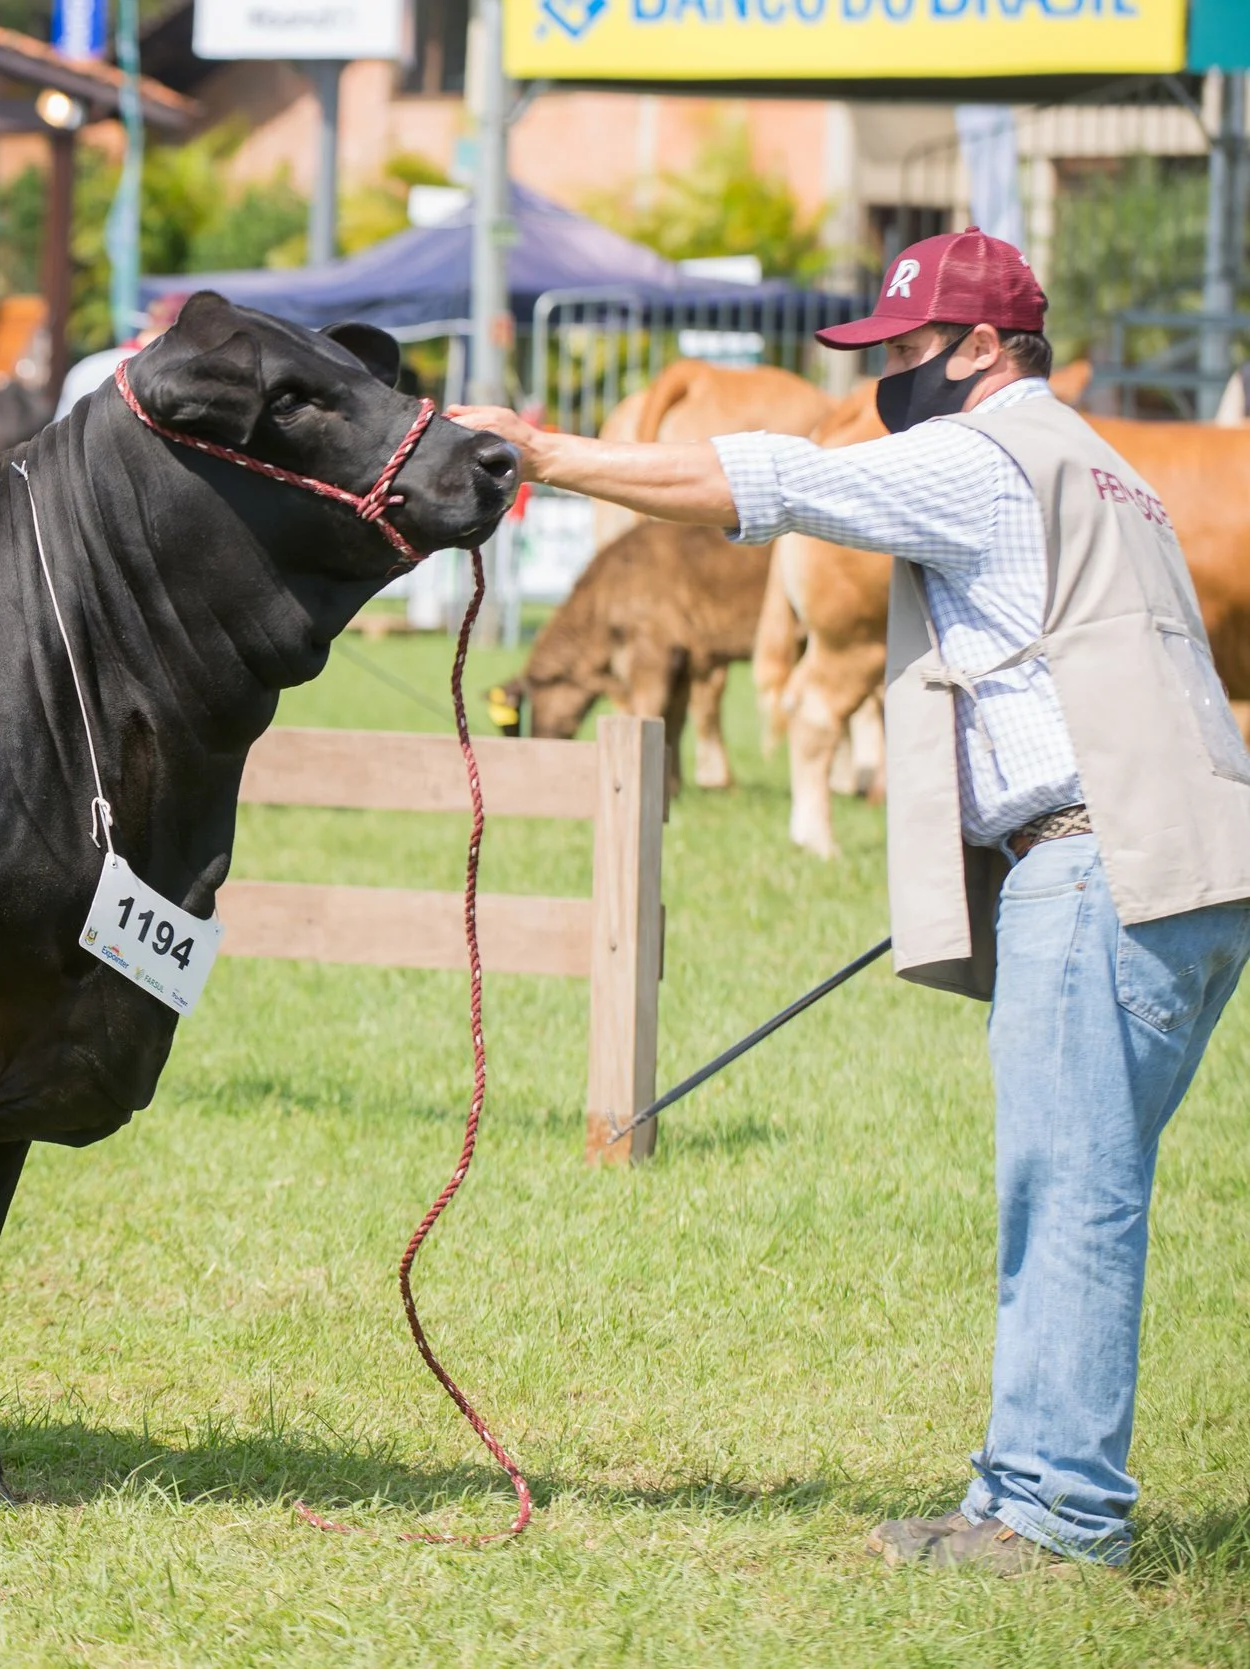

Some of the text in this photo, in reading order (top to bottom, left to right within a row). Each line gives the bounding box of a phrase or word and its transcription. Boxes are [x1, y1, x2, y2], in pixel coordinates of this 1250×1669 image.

[886, 259, 921, 298] R
[118, 896, 195, 971] 1194
[101, 945, 129, 969] Expointer
[144, 974, 164, 994] FARSUL
